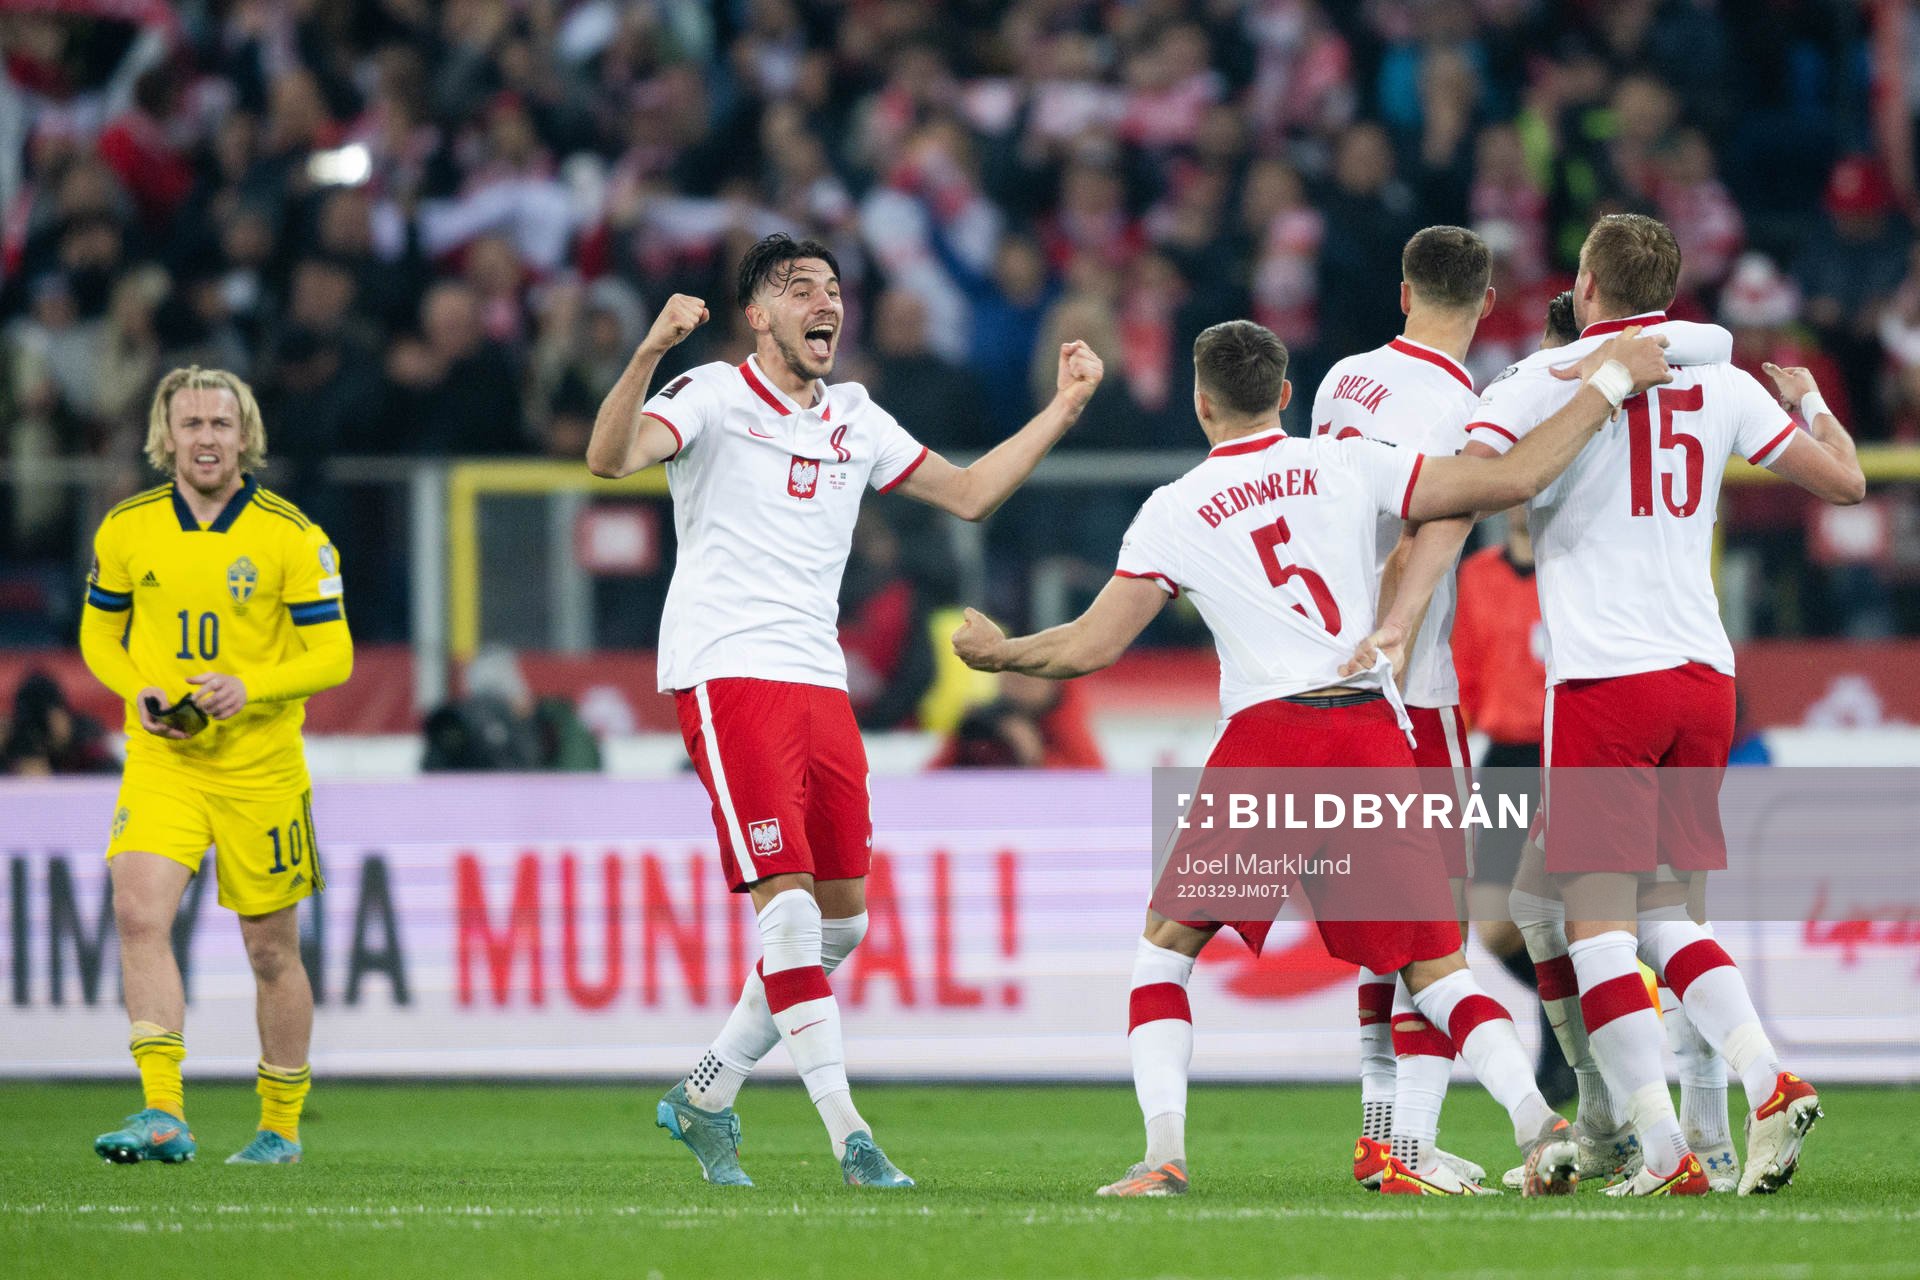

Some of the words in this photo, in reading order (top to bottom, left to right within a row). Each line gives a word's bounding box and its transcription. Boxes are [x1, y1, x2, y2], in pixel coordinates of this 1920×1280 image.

[1333, 374, 1391, 414] BIELIK
[1622, 383, 1704, 518] 15
[1197, 468, 1319, 529] BEDNAREK
[1250, 515, 1342, 637] 5
[176, 609, 219, 660] 10
[267, 819, 301, 874] 10
[452, 850, 1026, 1010] MUNAL!
